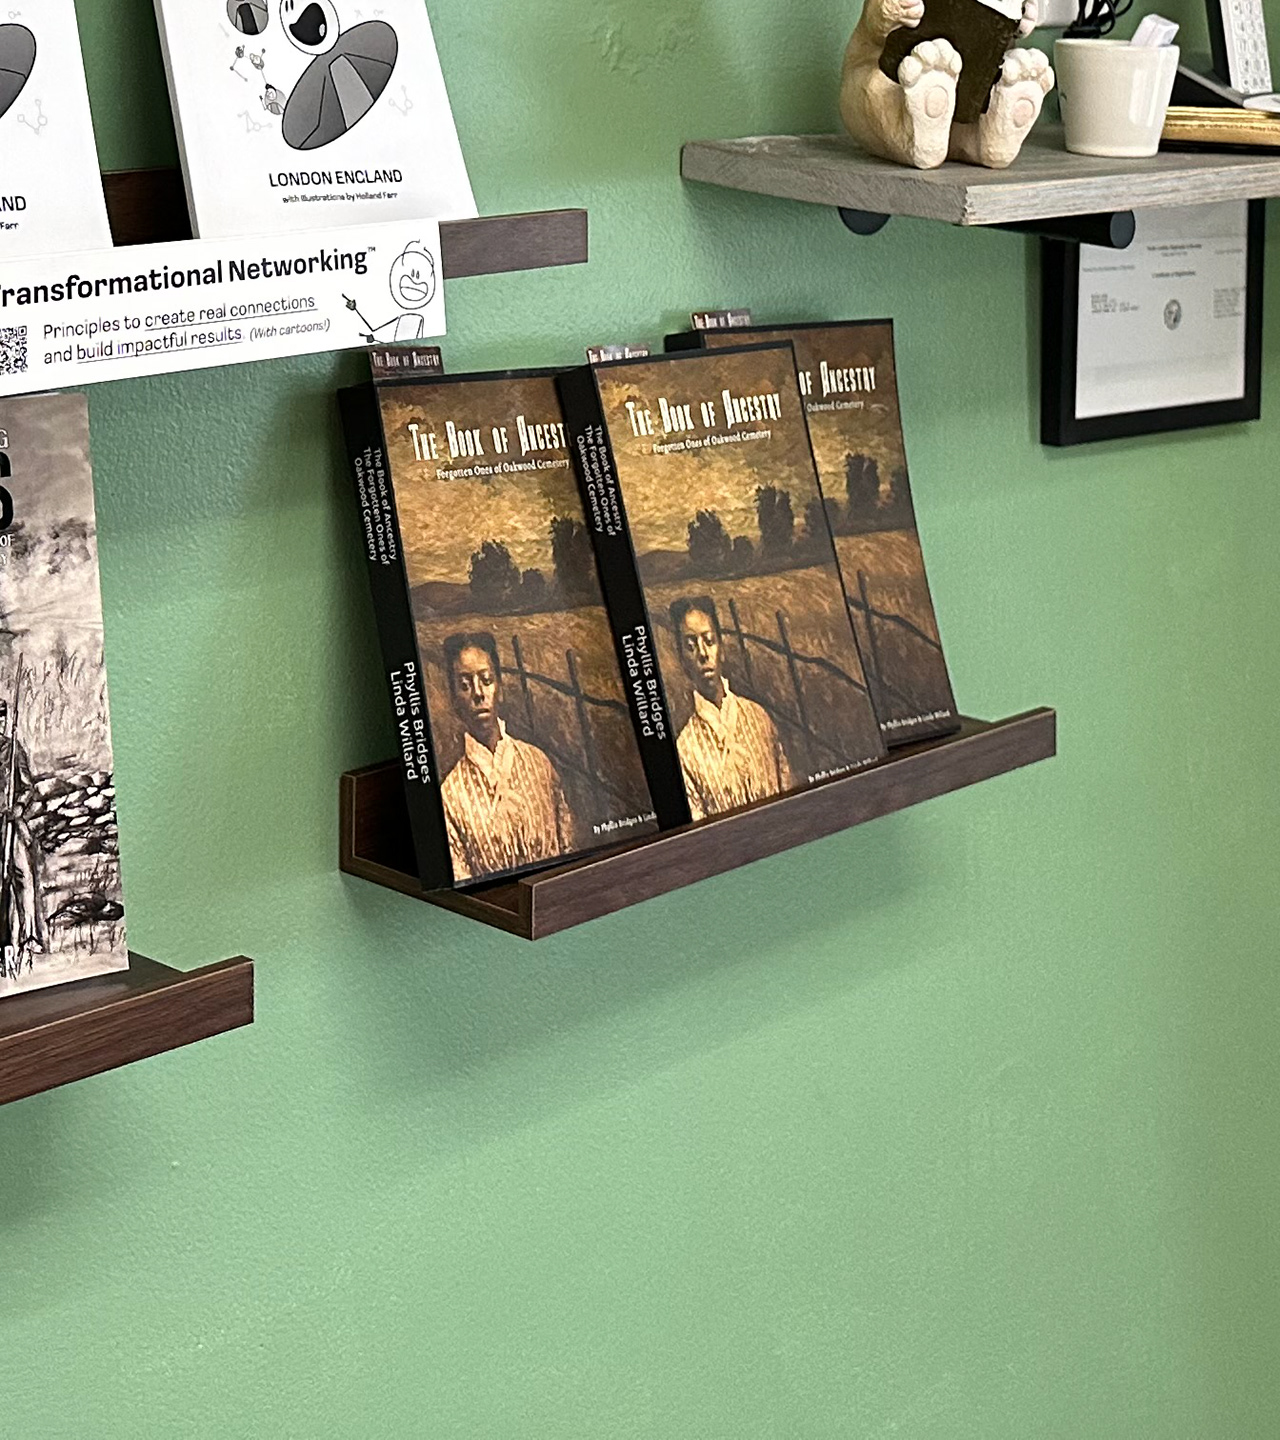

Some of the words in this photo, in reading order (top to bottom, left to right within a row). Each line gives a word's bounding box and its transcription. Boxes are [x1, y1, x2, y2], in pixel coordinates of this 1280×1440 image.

[269, 171, 333, 187] LONDON
[335, 169, 403, 185] ENGLAND
[0, 221, 19, 231] Farr
[43, 317, 121, 341] Principles
[124, 315, 141, 331] to
[144, 310, 196, 329] create
[199, 304, 227, 323] real
[229, 294, 316, 318] connections
[43, 346, 74, 366] and
[76, 337, 114, 360] build
[117, 332, 188, 357] impactful
[249, 325, 277, 343] (With
[279, 318, 331, 337] cartoons!)
[594, 424, 603, 445] The
[363, 446, 373, 468] The
[373, 446, 382, 468] The
[436, 465, 473, 481] Forgotten
[474, 464, 493, 477] Ones
[494, 462, 502, 474] of
[503, 459, 536, 474] Oakwood
[536, 457, 570, 474] Cemetery
[598, 446, 611, 473] Book
[354, 457, 371, 508] Oakwood
[366, 468, 381, 523] Forgotten
[376, 469, 389, 498] Book
[576, 434, 594, 483] Oakwood
[587, 483, 604, 533] Cemetery
[584, 424, 593, 444] The
[589, 445, 606, 496] Forgotten
[600, 496, 612, 524] Ones
[606, 524, 617, 536] of
[605, 473, 615, 484] of
[381, 499, 392, 511] of
[607, 486, 623, 531] Ancestry
[0, 533, 16, 547] OF
[362, 508, 378, 561] Cemetery
[375, 523, 386, 553] Ones
[384, 512, 397, 561] Ancestry
[380, 553, 391, 566] of
[621, 634, 638, 677] Linda
[632, 679, 655, 738] Willard
[634, 625, 653, 676] Phyllis
[647, 677, 667, 741] Bridges
[390, 671, 406, 716] Linda
[398, 718, 419, 782] Willard
[404, 661, 420, 716] Phyllis
[412, 718, 432, 785] Bridges
